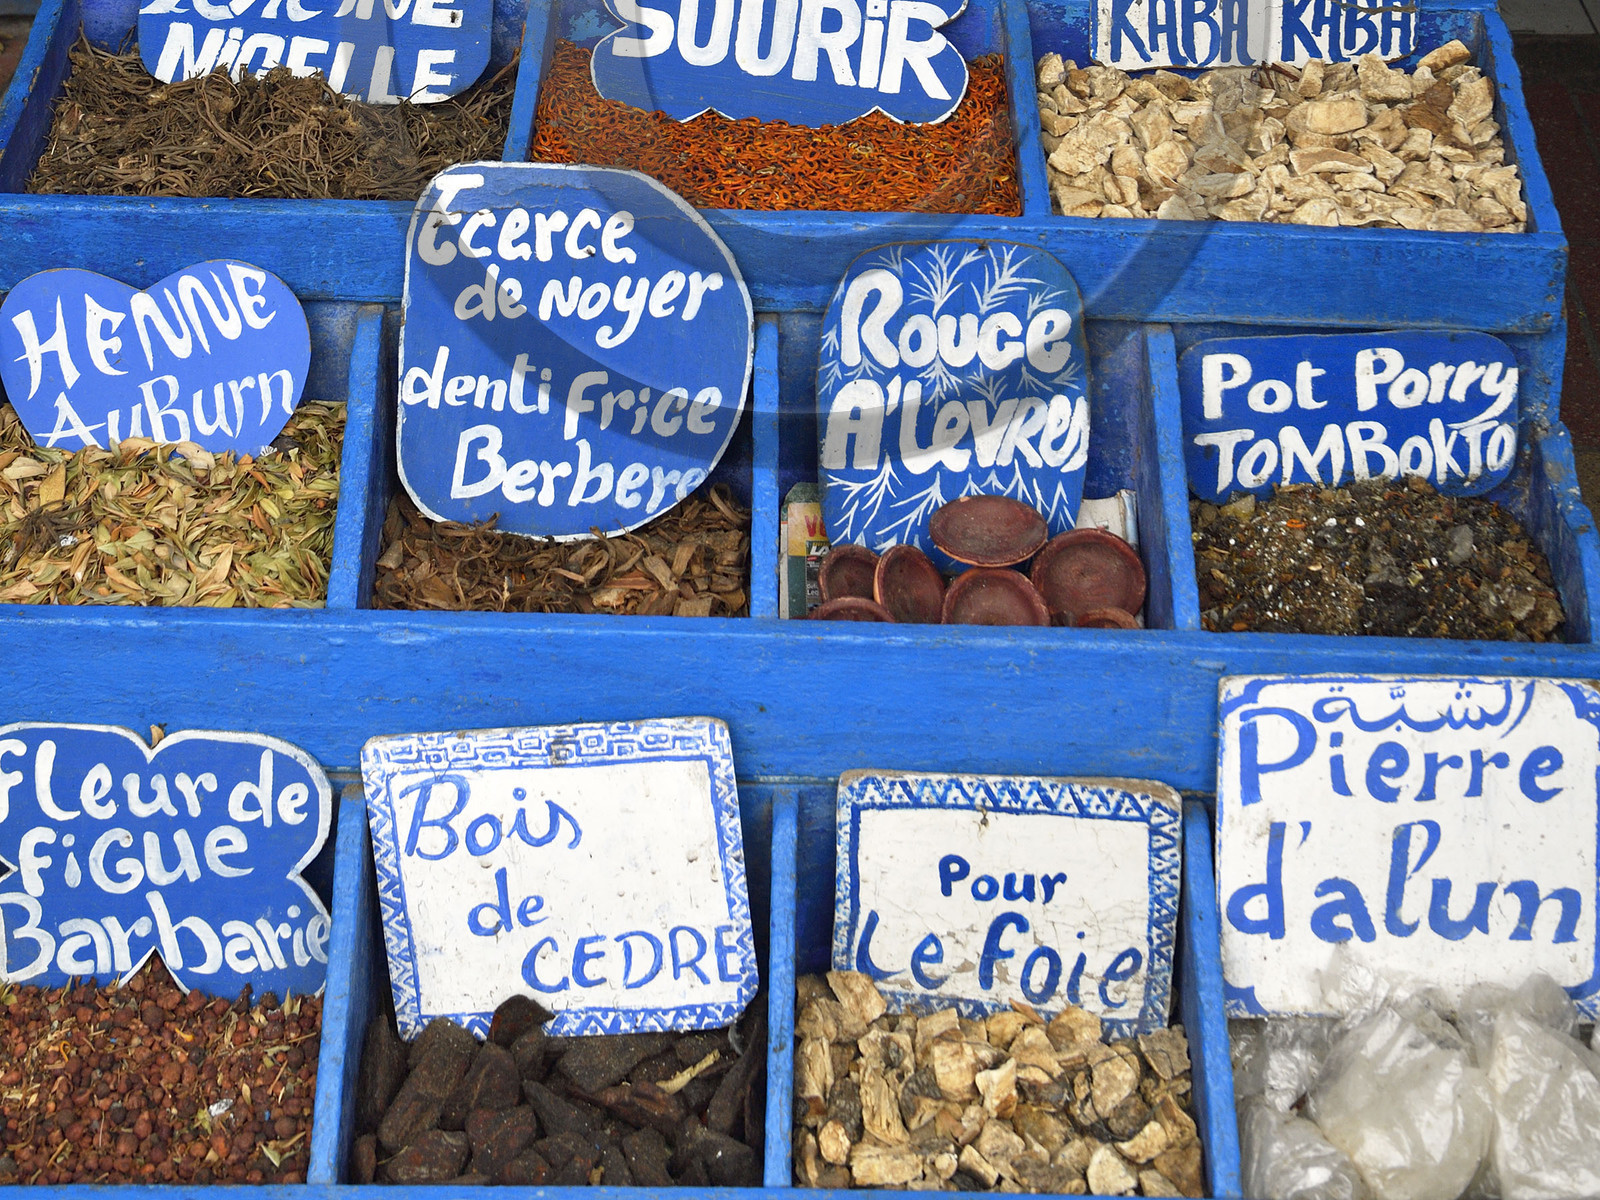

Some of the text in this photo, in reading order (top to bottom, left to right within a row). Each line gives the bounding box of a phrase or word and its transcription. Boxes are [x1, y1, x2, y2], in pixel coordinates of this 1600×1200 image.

[11, 263, 277, 401] HENNE
[453, 262, 528, 322] de
[401, 345, 553, 415] denti
[1201, 346, 1520, 430] Pot Porry
[450, 423, 710, 514] Berbere
[227, 748, 310, 828] de
[1238, 706, 1565, 807] Pierre
[399, 773, 584, 861] Bois
[466, 866, 551, 938] de
[937, 853, 1068, 905] Pour
[0, 889, 331, 985] Barbarie
[520, 924, 744, 994] CEDRE
[855, 909, 950, 991] Le
